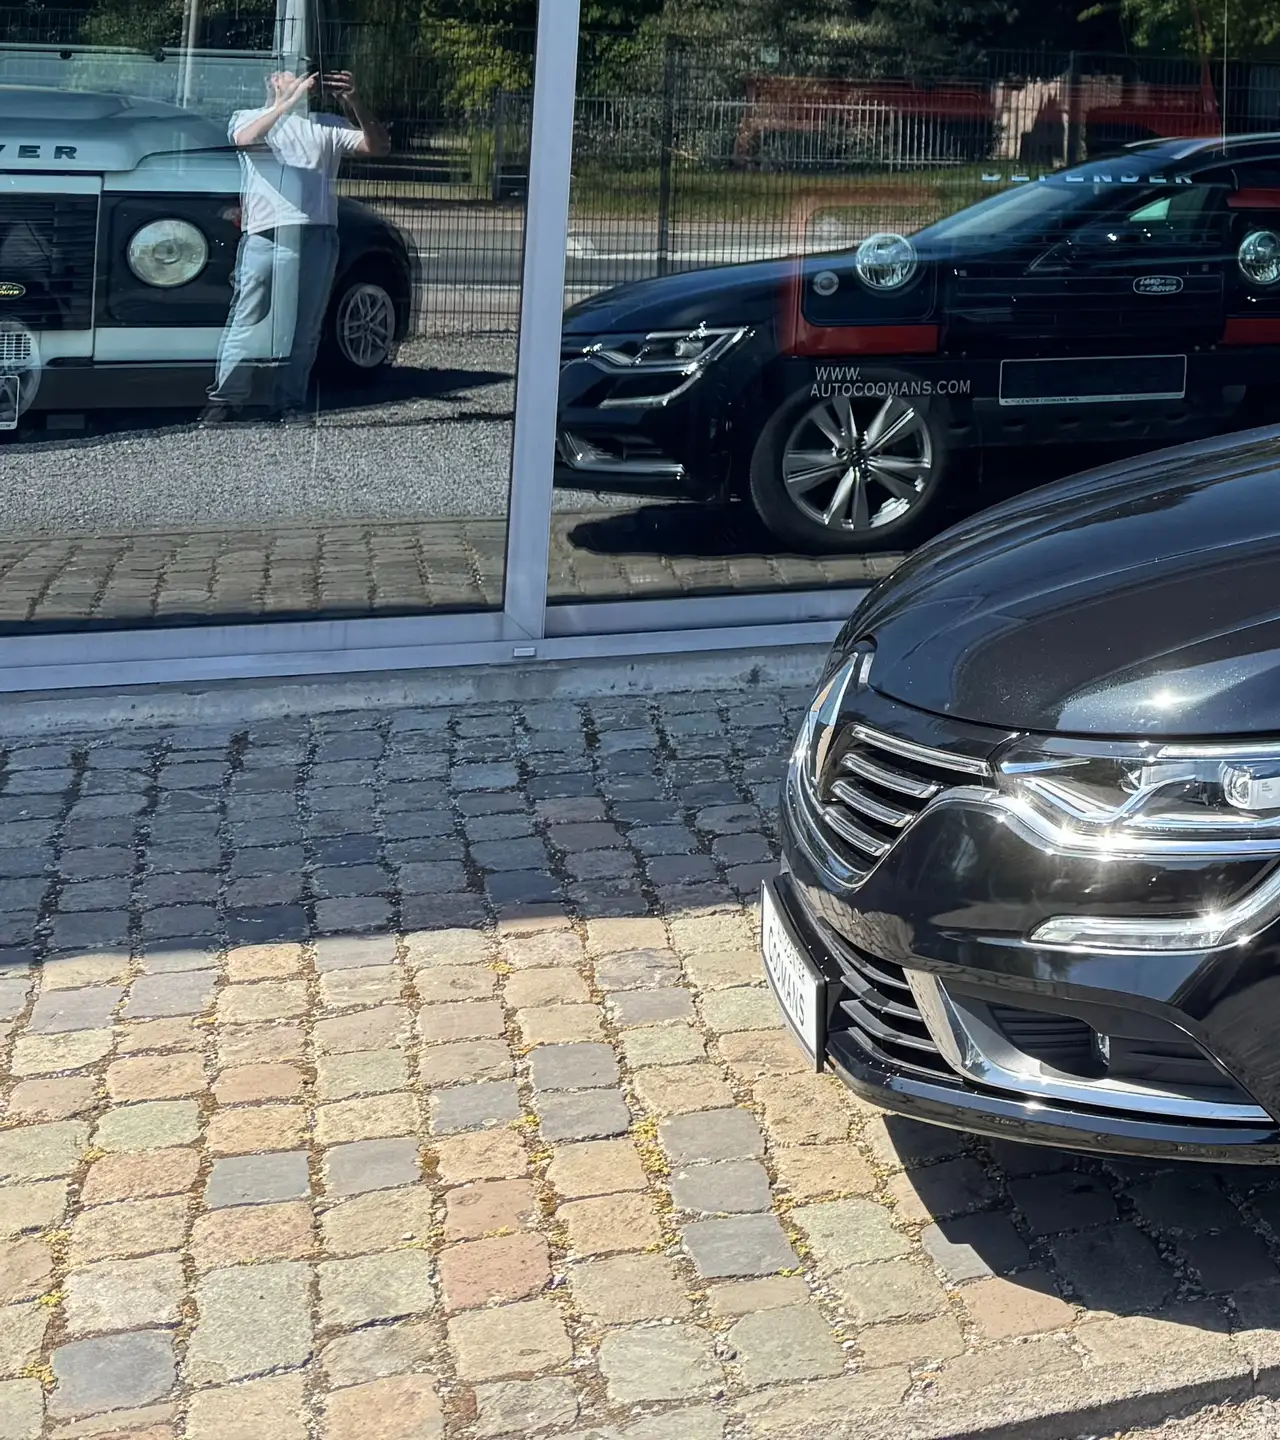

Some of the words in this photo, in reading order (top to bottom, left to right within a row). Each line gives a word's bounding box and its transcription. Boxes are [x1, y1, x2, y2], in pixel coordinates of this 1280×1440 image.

[0, 144, 77, 160] ER
[815, 366, 861, 380] WWW.
[810, 379, 971, 397] AUTOCOOMANS.COM
